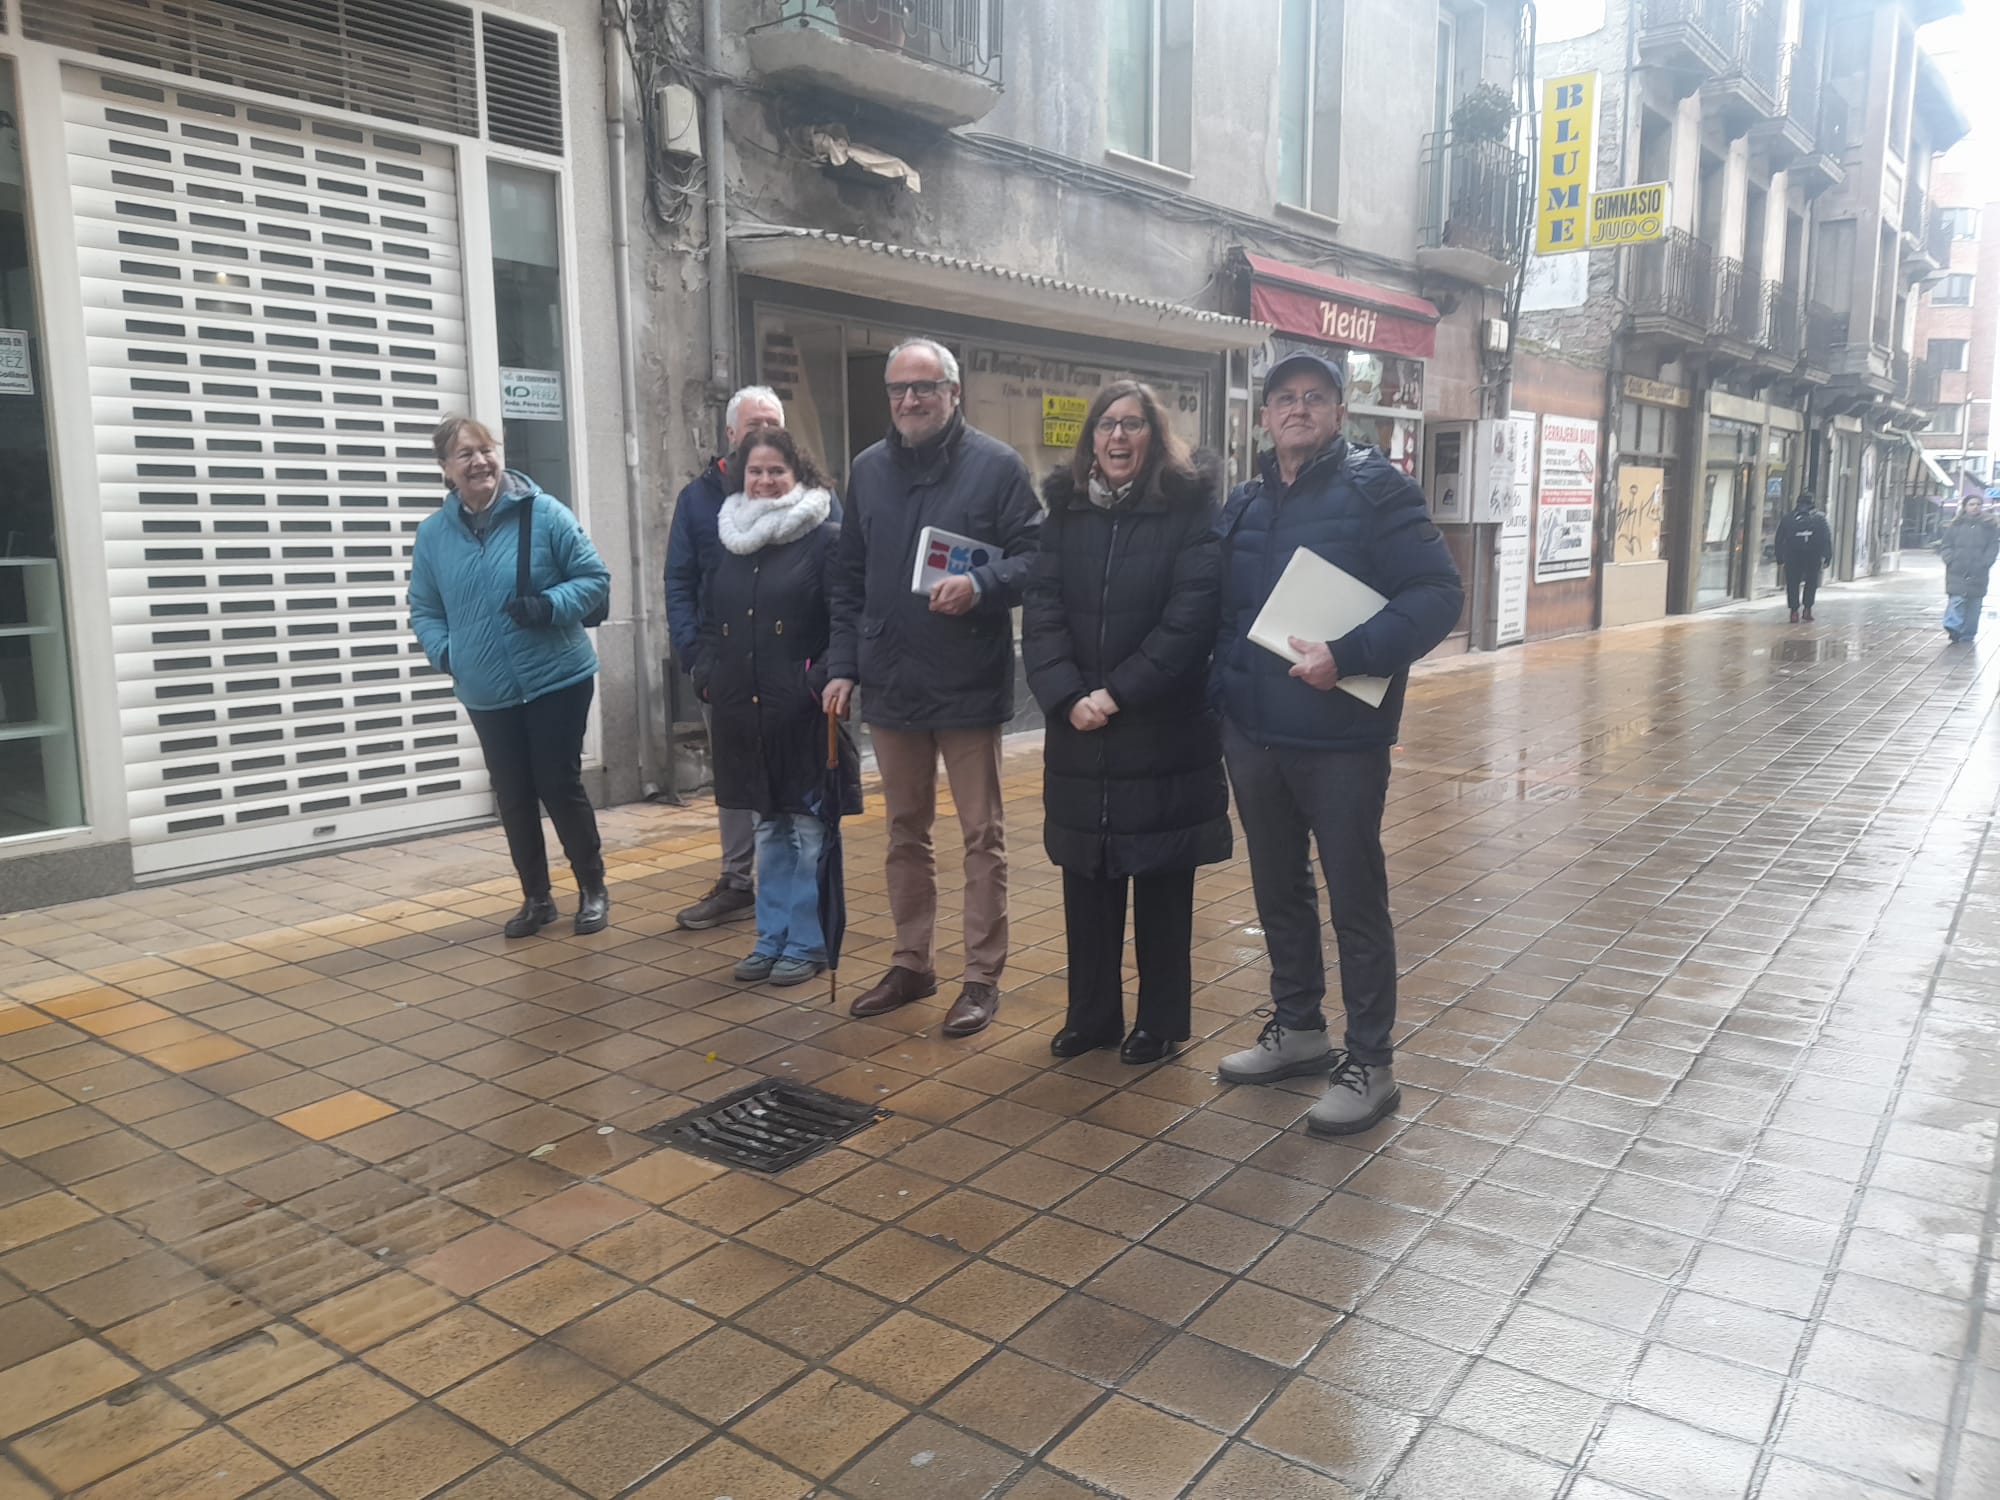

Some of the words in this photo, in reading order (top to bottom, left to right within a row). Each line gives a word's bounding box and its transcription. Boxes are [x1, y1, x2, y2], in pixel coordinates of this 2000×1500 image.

[1545, 83, 1584, 244] BLUME
[1594, 188, 1662, 222] GIMNASIO
[1592, 217, 1660, 243] JUDO
[1320, 301, 1378, 344] Heidi
